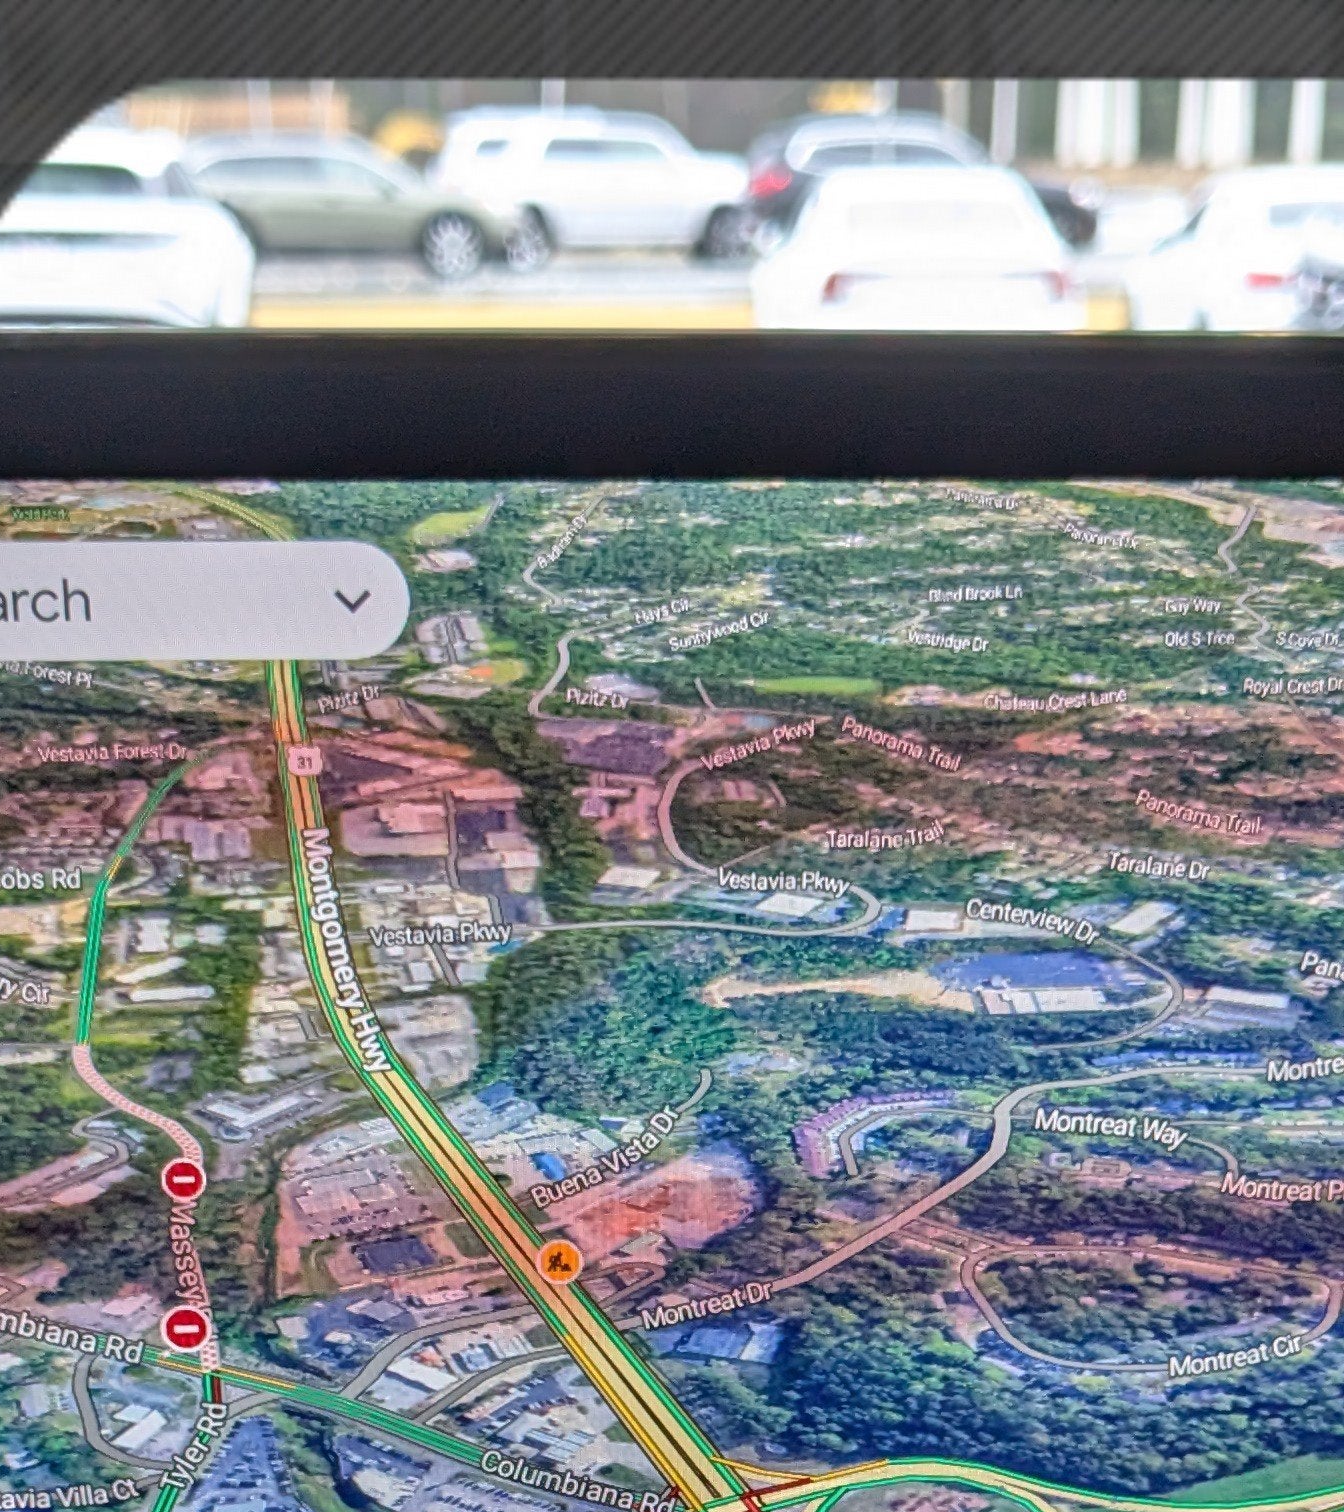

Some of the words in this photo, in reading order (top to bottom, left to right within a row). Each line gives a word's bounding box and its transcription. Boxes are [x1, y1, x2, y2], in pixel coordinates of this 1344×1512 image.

[37, 744, 111, 764] Vestavia
[700, 735, 771, 771] Vestavia
[840, 715, 924, 759] Panorama
[1135, 788, 1221, 830] Panorama
[51, 866, 82, 891] Rd
[717, 866, 797, 893] Vestavia
[799, 870, 852, 899] Pkwy
[1188, 860, 1210, 882] Dr
[369, 926, 455, 947] Vestavia
[459, 921, 513, 946] Pkwy
[965, 897, 1076, 935] Centerview
[1076, 918, 1101, 946] Dr
[301, 826, 363, 1011] Montgomery
[350, 1011, 392, 1074] Hwy
[20, 982, 51, 1004] Cir
[1034, 1107, 1137, 1139] Montreat
[1141, 1115, 1189, 1152] Way
[528, 1166, 602, 1210] Buena
[604, 1130, 663, 1174] Vista
[647, 1103, 681, 1139] Dr
[1219, 1171, 1322, 1202] Montreat
[169, 1200, 204, 1301] Massey
[641, 1288, 743, 1331] Montreat
[743, 1279, 773, 1305] Dr
[101, 1335, 145, 1366] Rd
[1168, 1342, 1270, 1378] Montreat
[1271, 1333, 1303, 1358] Cir
[160, 1438, 211, 1491] Tyler
[198, 1401, 228, 1438] Rd
[56, 1483, 109, 1509] Villa
[111, 1477, 141, 1502] Ct
